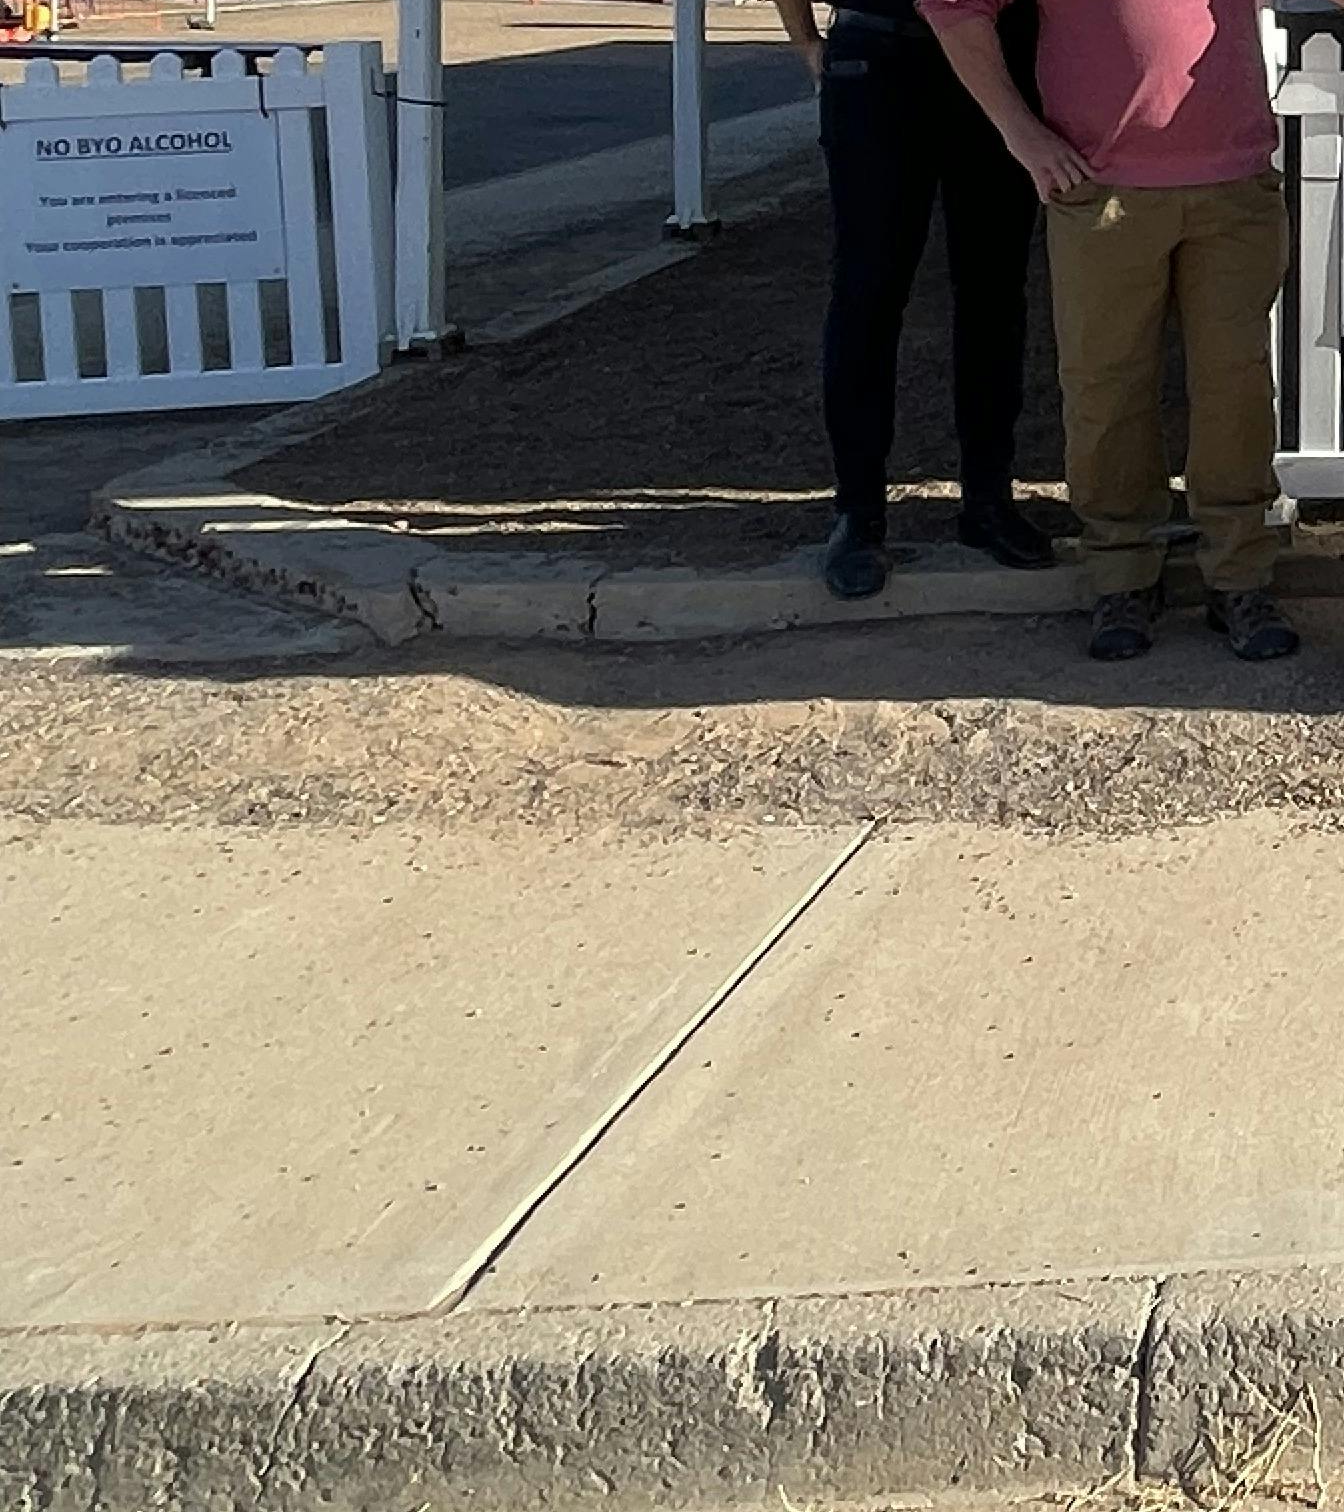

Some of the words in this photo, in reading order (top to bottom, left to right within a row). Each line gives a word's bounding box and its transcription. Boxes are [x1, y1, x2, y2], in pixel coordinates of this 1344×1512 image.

[36, 138, 70, 156] NO
[76, 136, 122, 154] BYO
[129, 131, 232, 150] ALCOHOL
